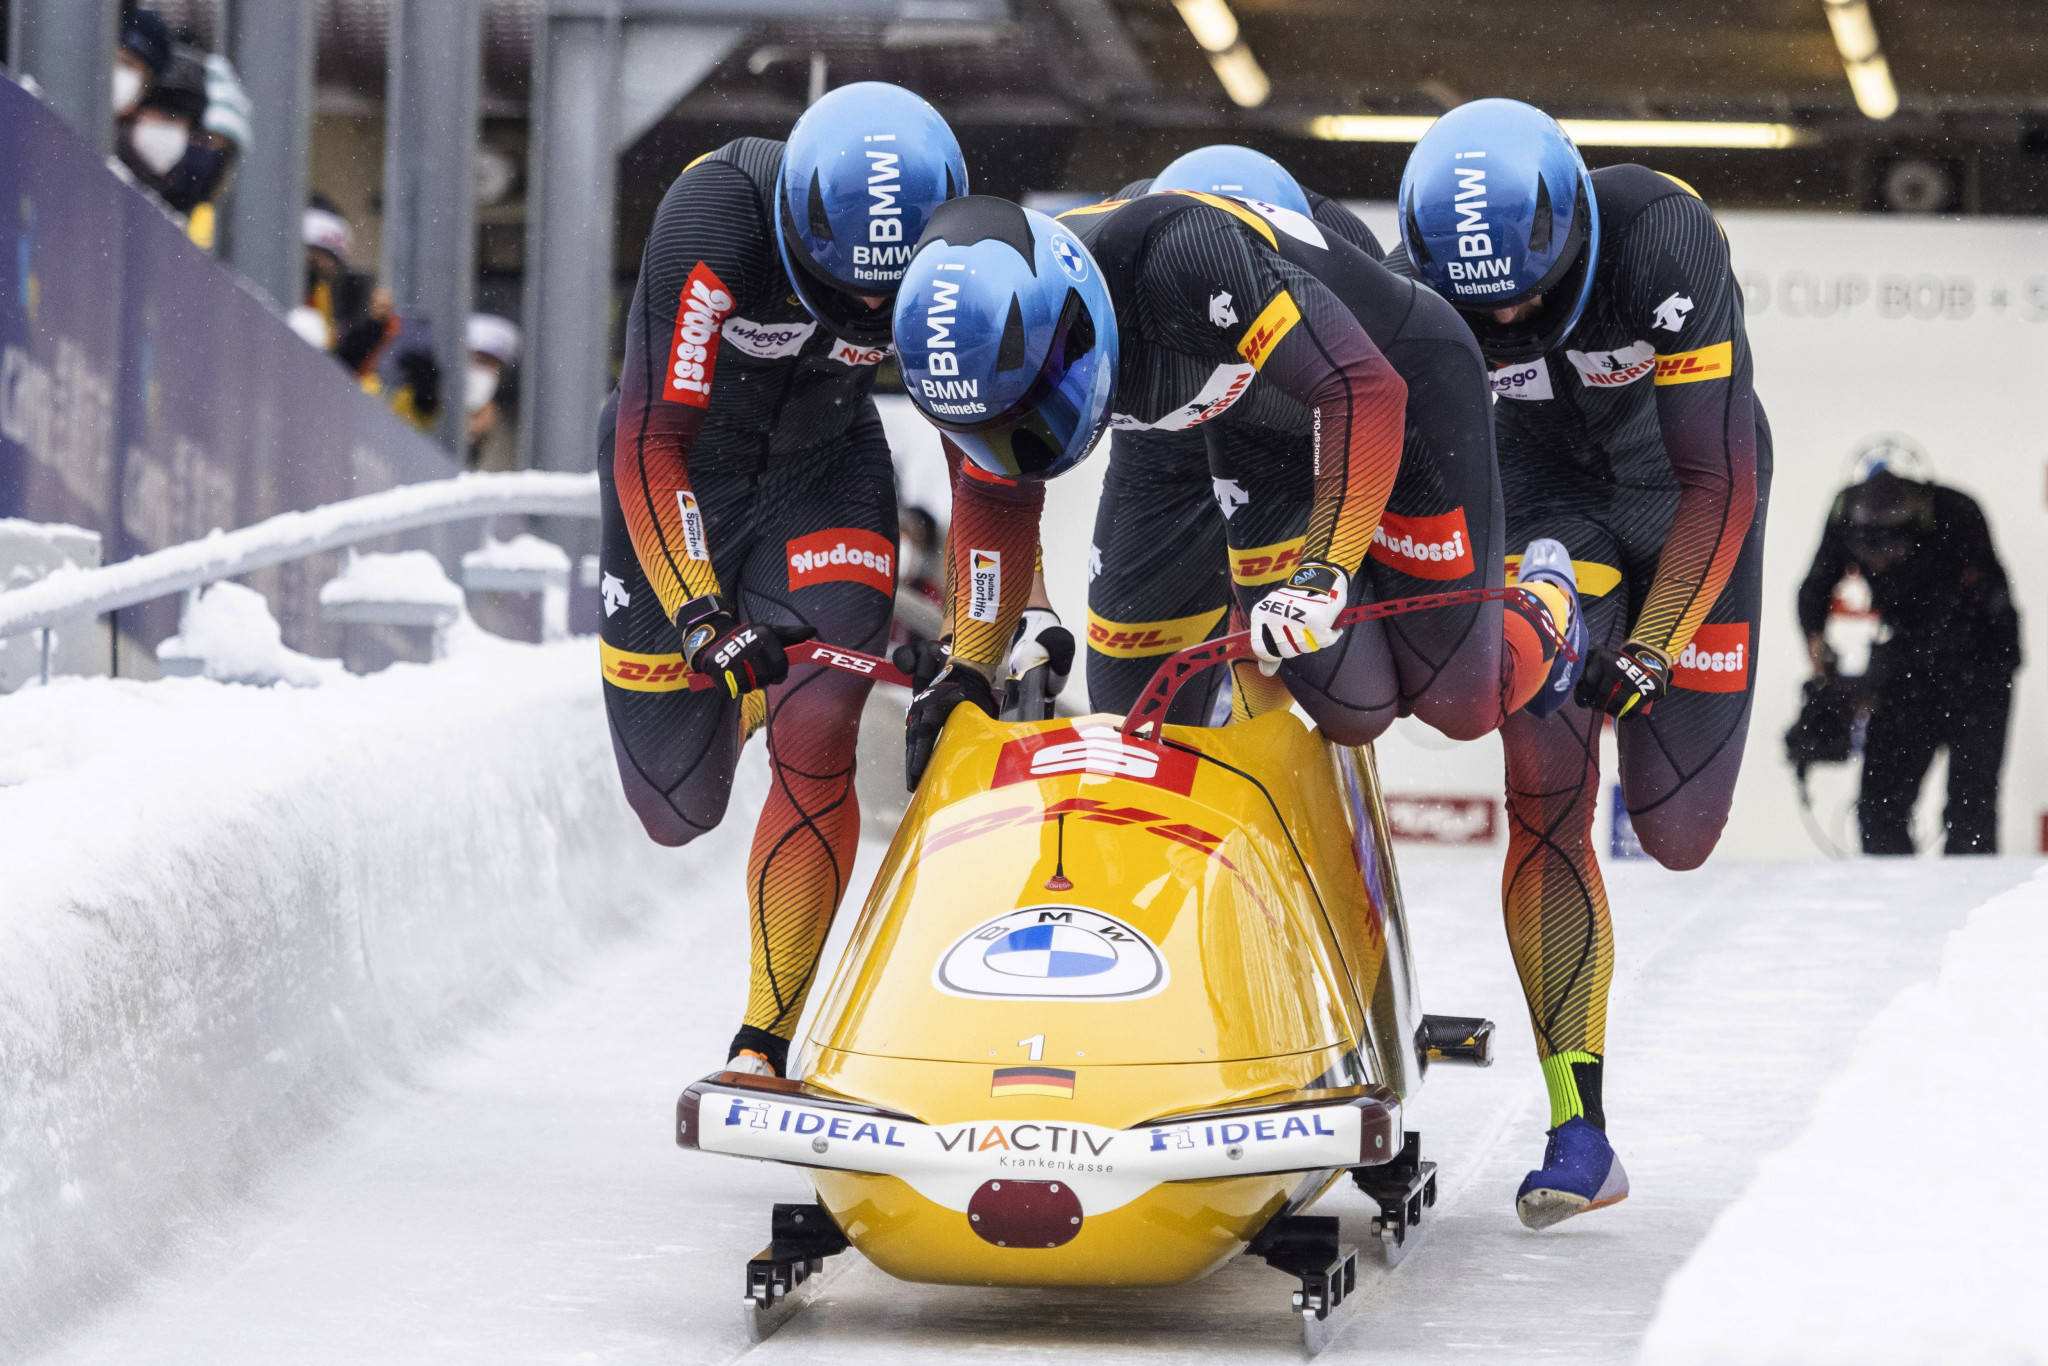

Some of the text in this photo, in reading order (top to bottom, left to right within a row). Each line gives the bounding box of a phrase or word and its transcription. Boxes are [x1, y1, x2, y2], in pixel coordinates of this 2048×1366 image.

[864, 134, 903, 243] BMW i
[1454, 151, 1493, 258] BMW i
[853, 244, 917, 266] BMW
[1447, 257, 1512, 281] BMW
[854, 266, 907, 281] helme
[1454, 279, 1516, 295] helmets
[926, 263, 966, 376] BMW i
[1245, 325, 1275, 364] HL
[1656, 357, 1703, 377] HL
[921, 378, 978, 400] BMW
[929, 401, 987, 415] helmets
[790, 543, 891, 577] Nudossi
[1239, 546, 1304, 577] DH
[617, 660, 689, 683] DH
[811, 648, 877, 674] FES
[1674, 643, 1744, 672] dossi
[973, 912, 1136, 943] BMW
[1017, 1033, 1046, 1061] 1
[779, 1109, 905, 1148] IDEAL
[935, 1124, 1115, 1156] VIACTIV
[1206, 1114, 1335, 1147] IDEAL
[1000, 1156, 1114, 1174] Krankenkasse
